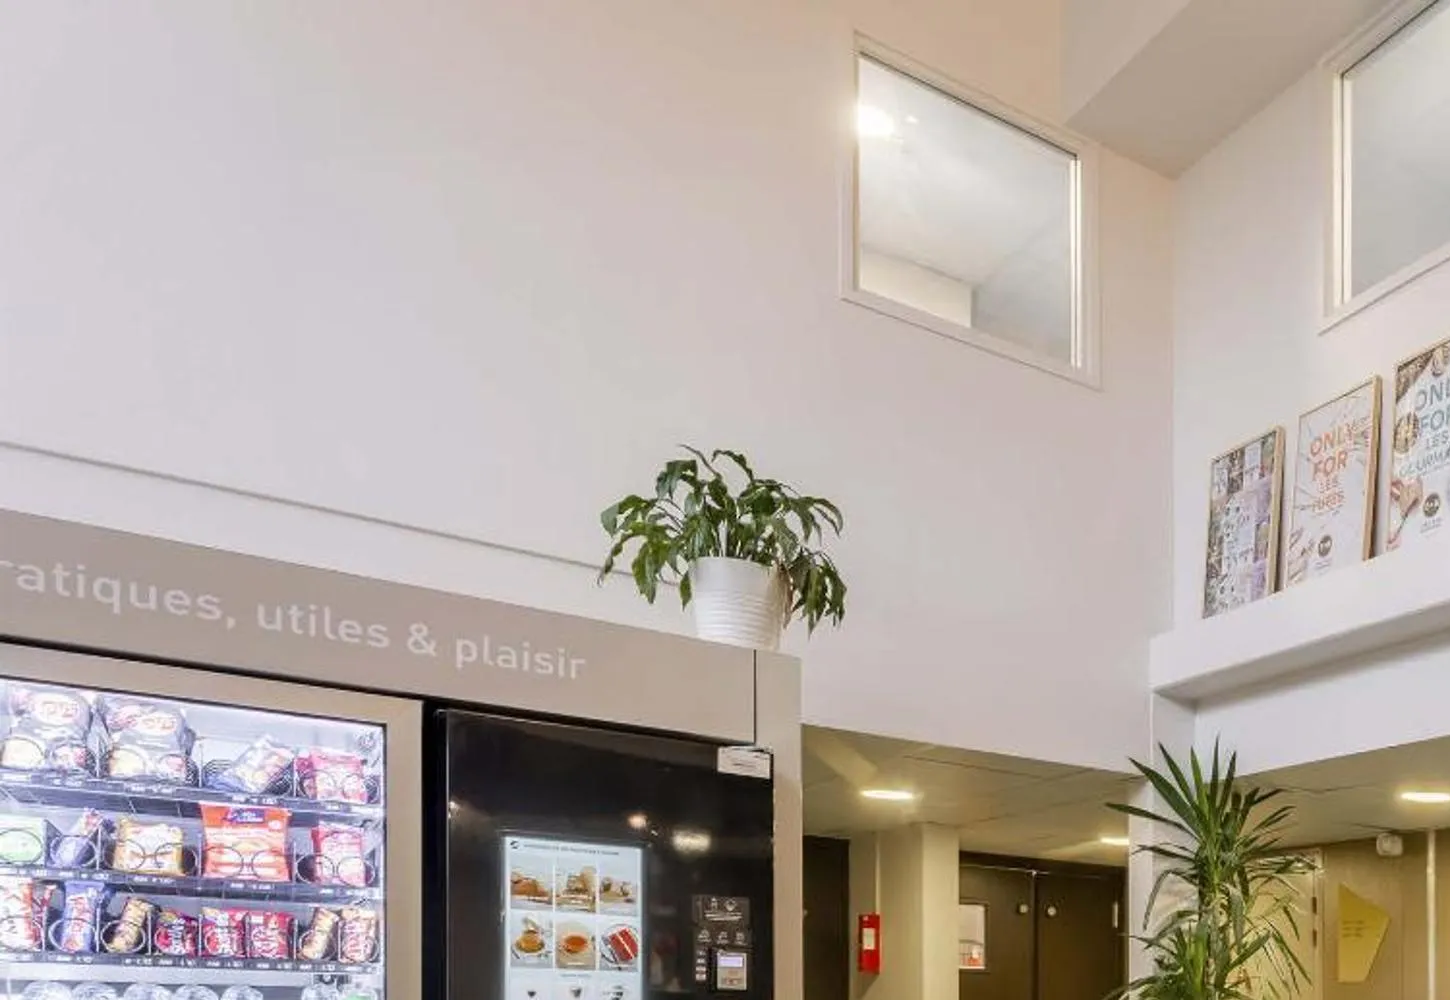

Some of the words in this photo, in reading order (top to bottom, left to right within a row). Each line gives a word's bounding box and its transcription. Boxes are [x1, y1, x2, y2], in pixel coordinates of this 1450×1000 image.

[1312, 449, 1348, 481] FOR
[257, 603, 389, 649] utiles
[406, 622, 437, 657] &
[456, 635, 586, 680] plaisir
